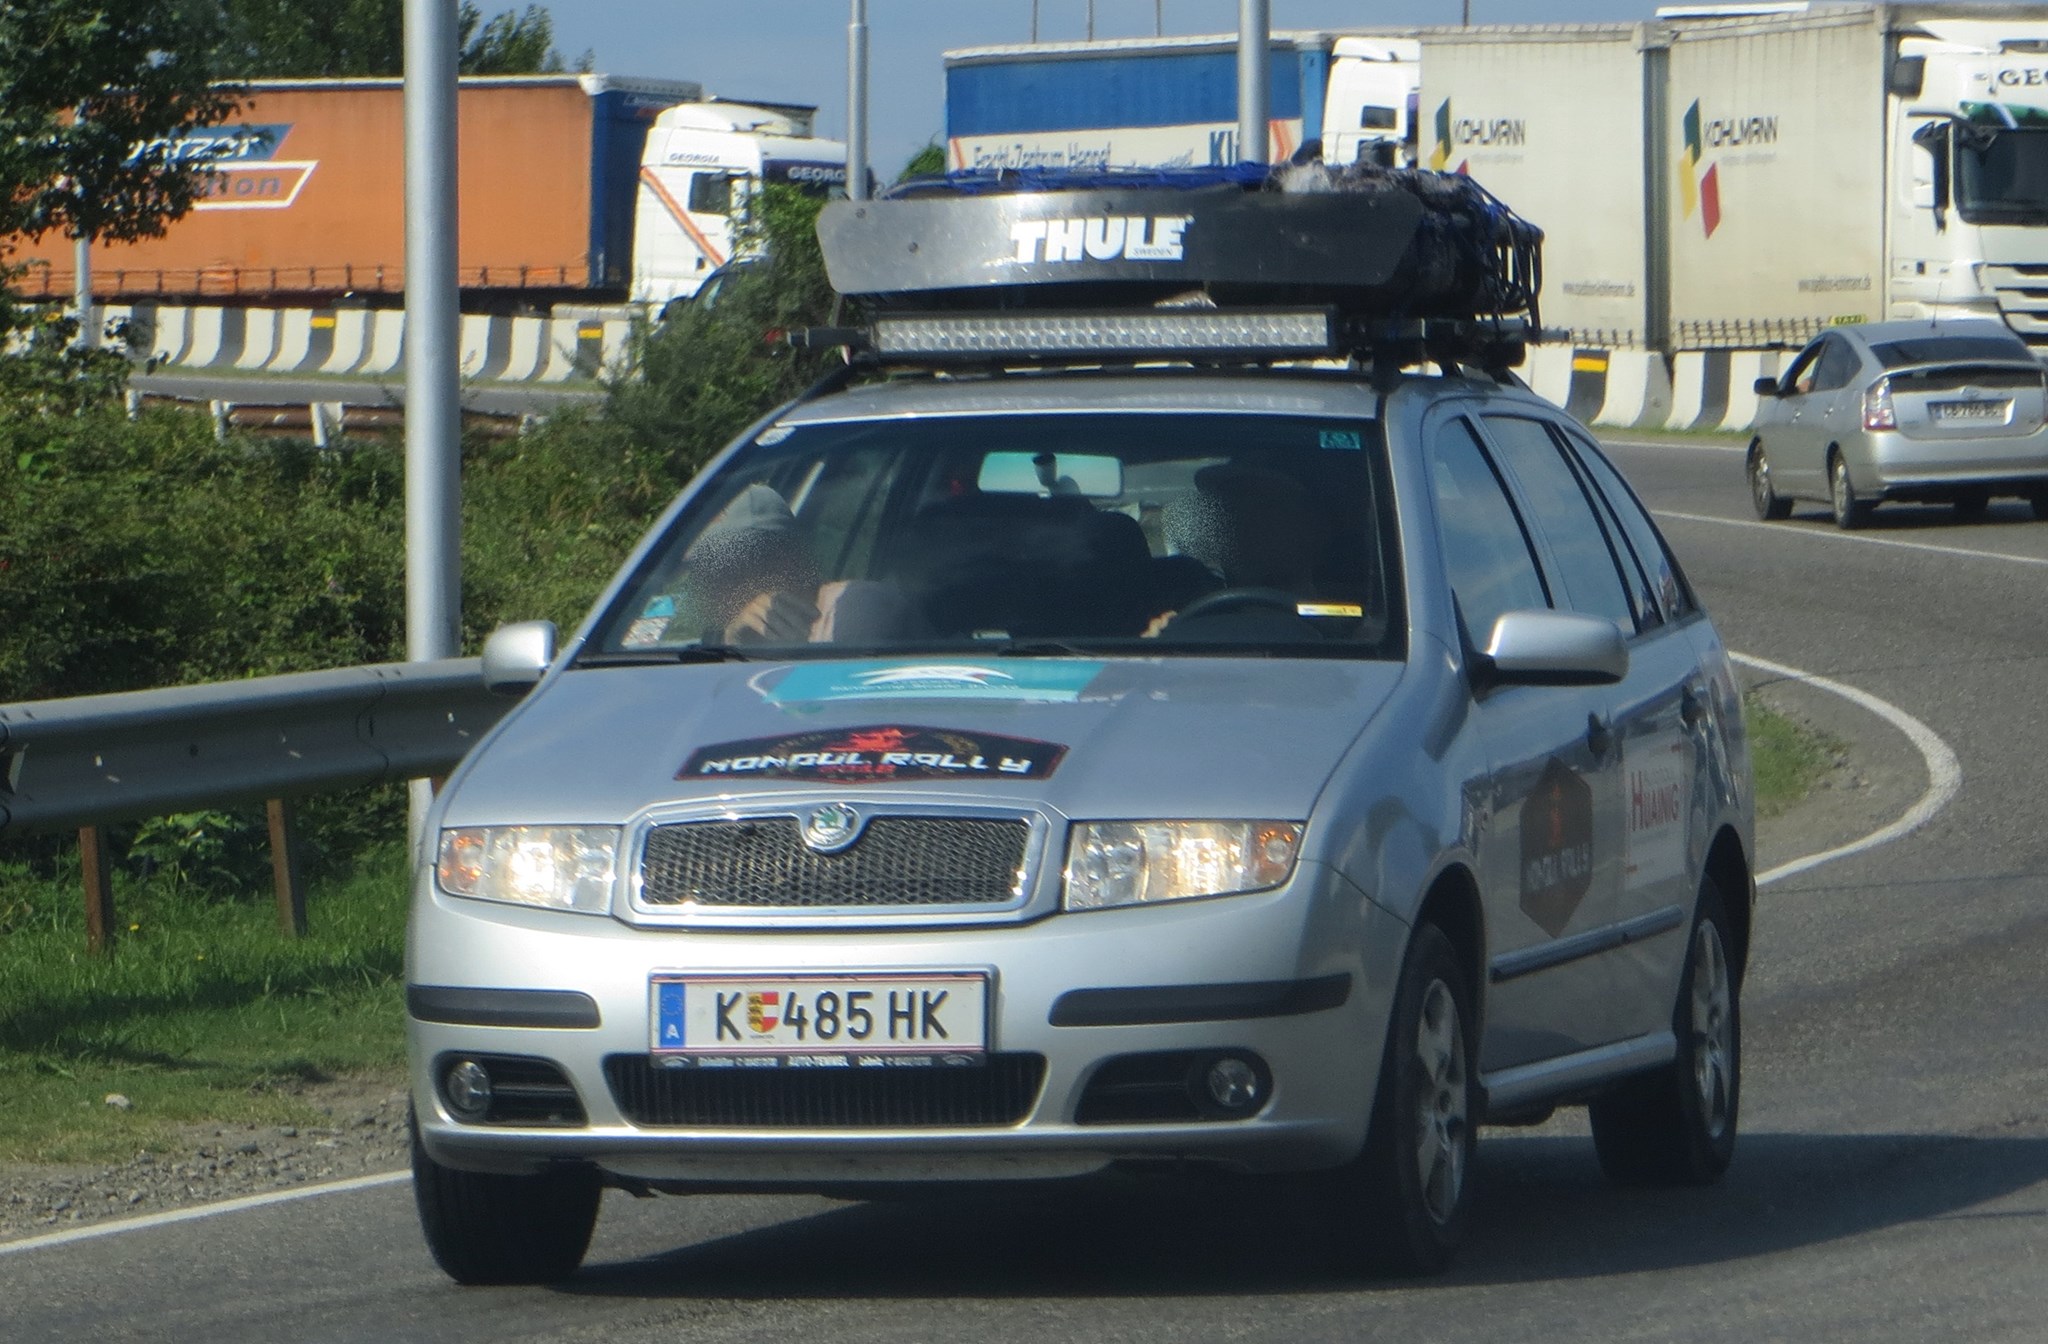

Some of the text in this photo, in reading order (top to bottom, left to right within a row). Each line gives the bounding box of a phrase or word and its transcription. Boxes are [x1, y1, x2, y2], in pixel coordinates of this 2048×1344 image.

[1998, 68, 2048, 85] GE
[1010, 216, 1186, 263] THULE
[880, 752, 1031, 773] RALLY
[716, 988, 949, 1041] K 485 HK
[665, 1024, 680, 1039] A
